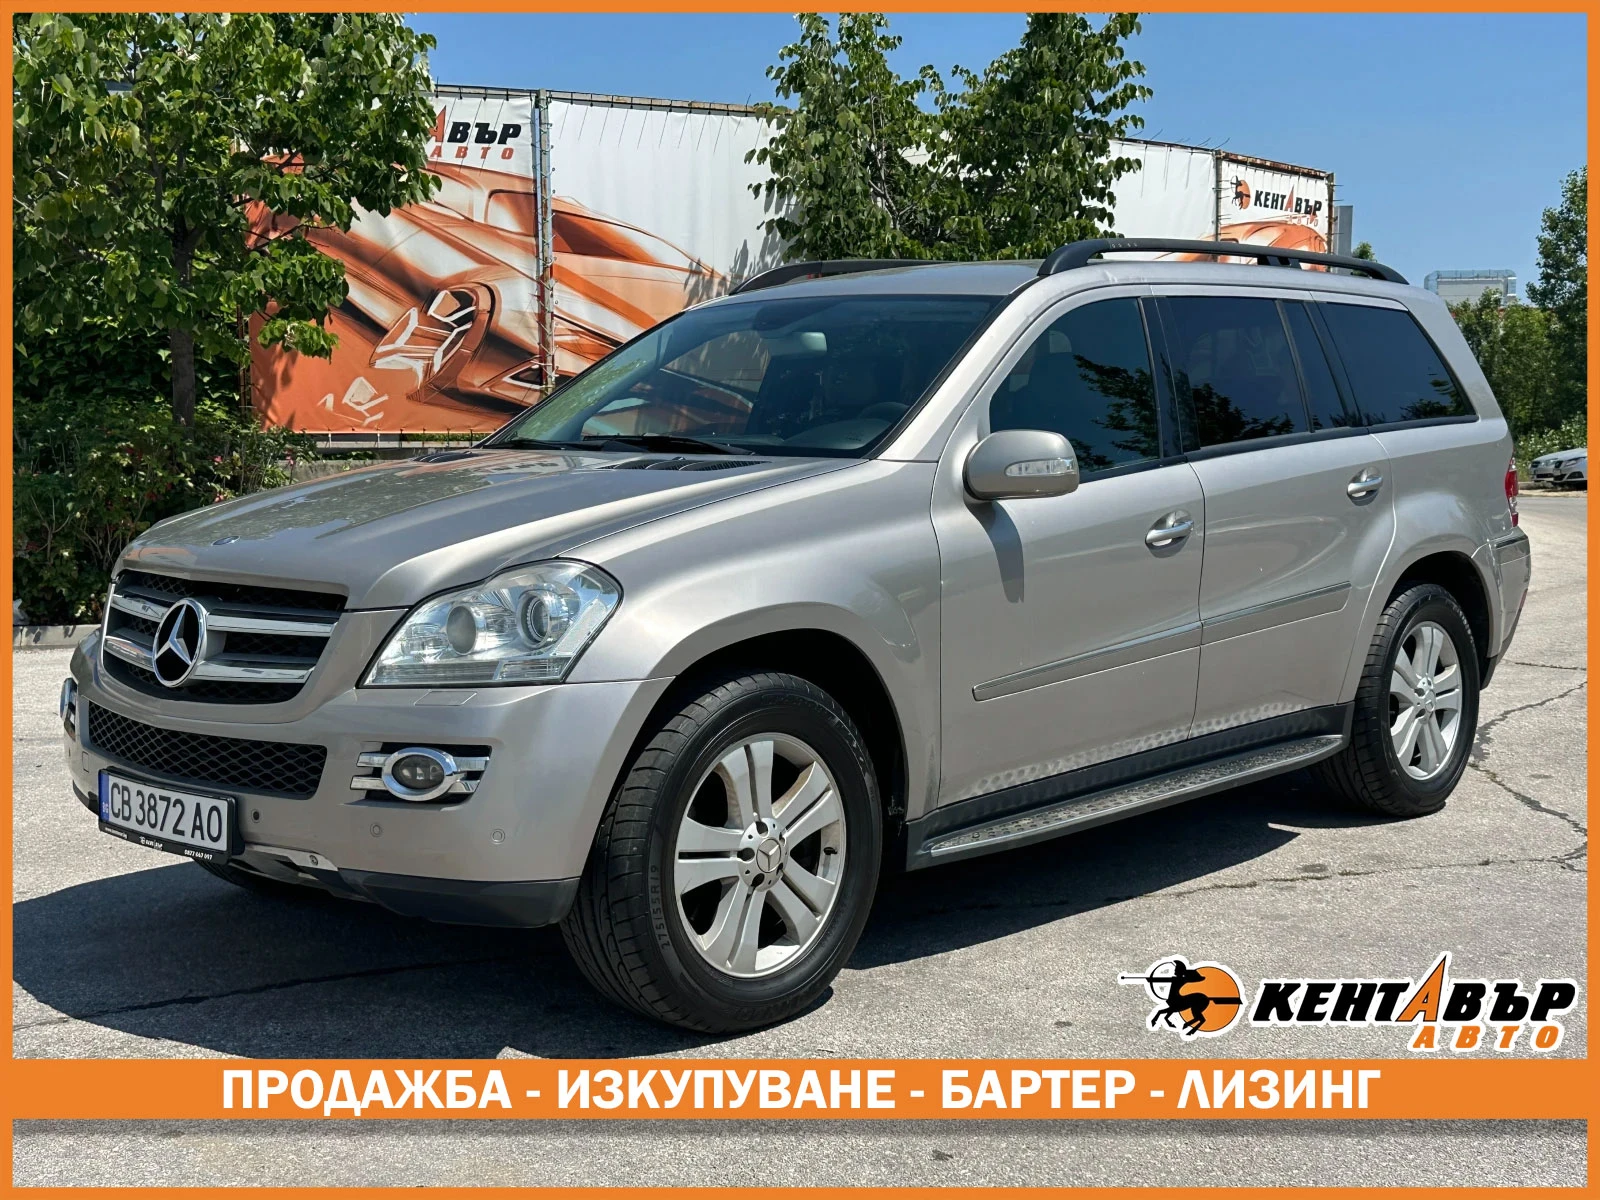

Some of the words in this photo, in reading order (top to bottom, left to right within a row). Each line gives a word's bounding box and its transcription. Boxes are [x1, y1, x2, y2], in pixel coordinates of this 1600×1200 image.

[428, 105, 521, 144] АВЪР
[430, 146, 514, 160] АВТО
[1254, 184, 1322, 215] КЕНТАВЪР
[135, 790, 186, 837] 3872
